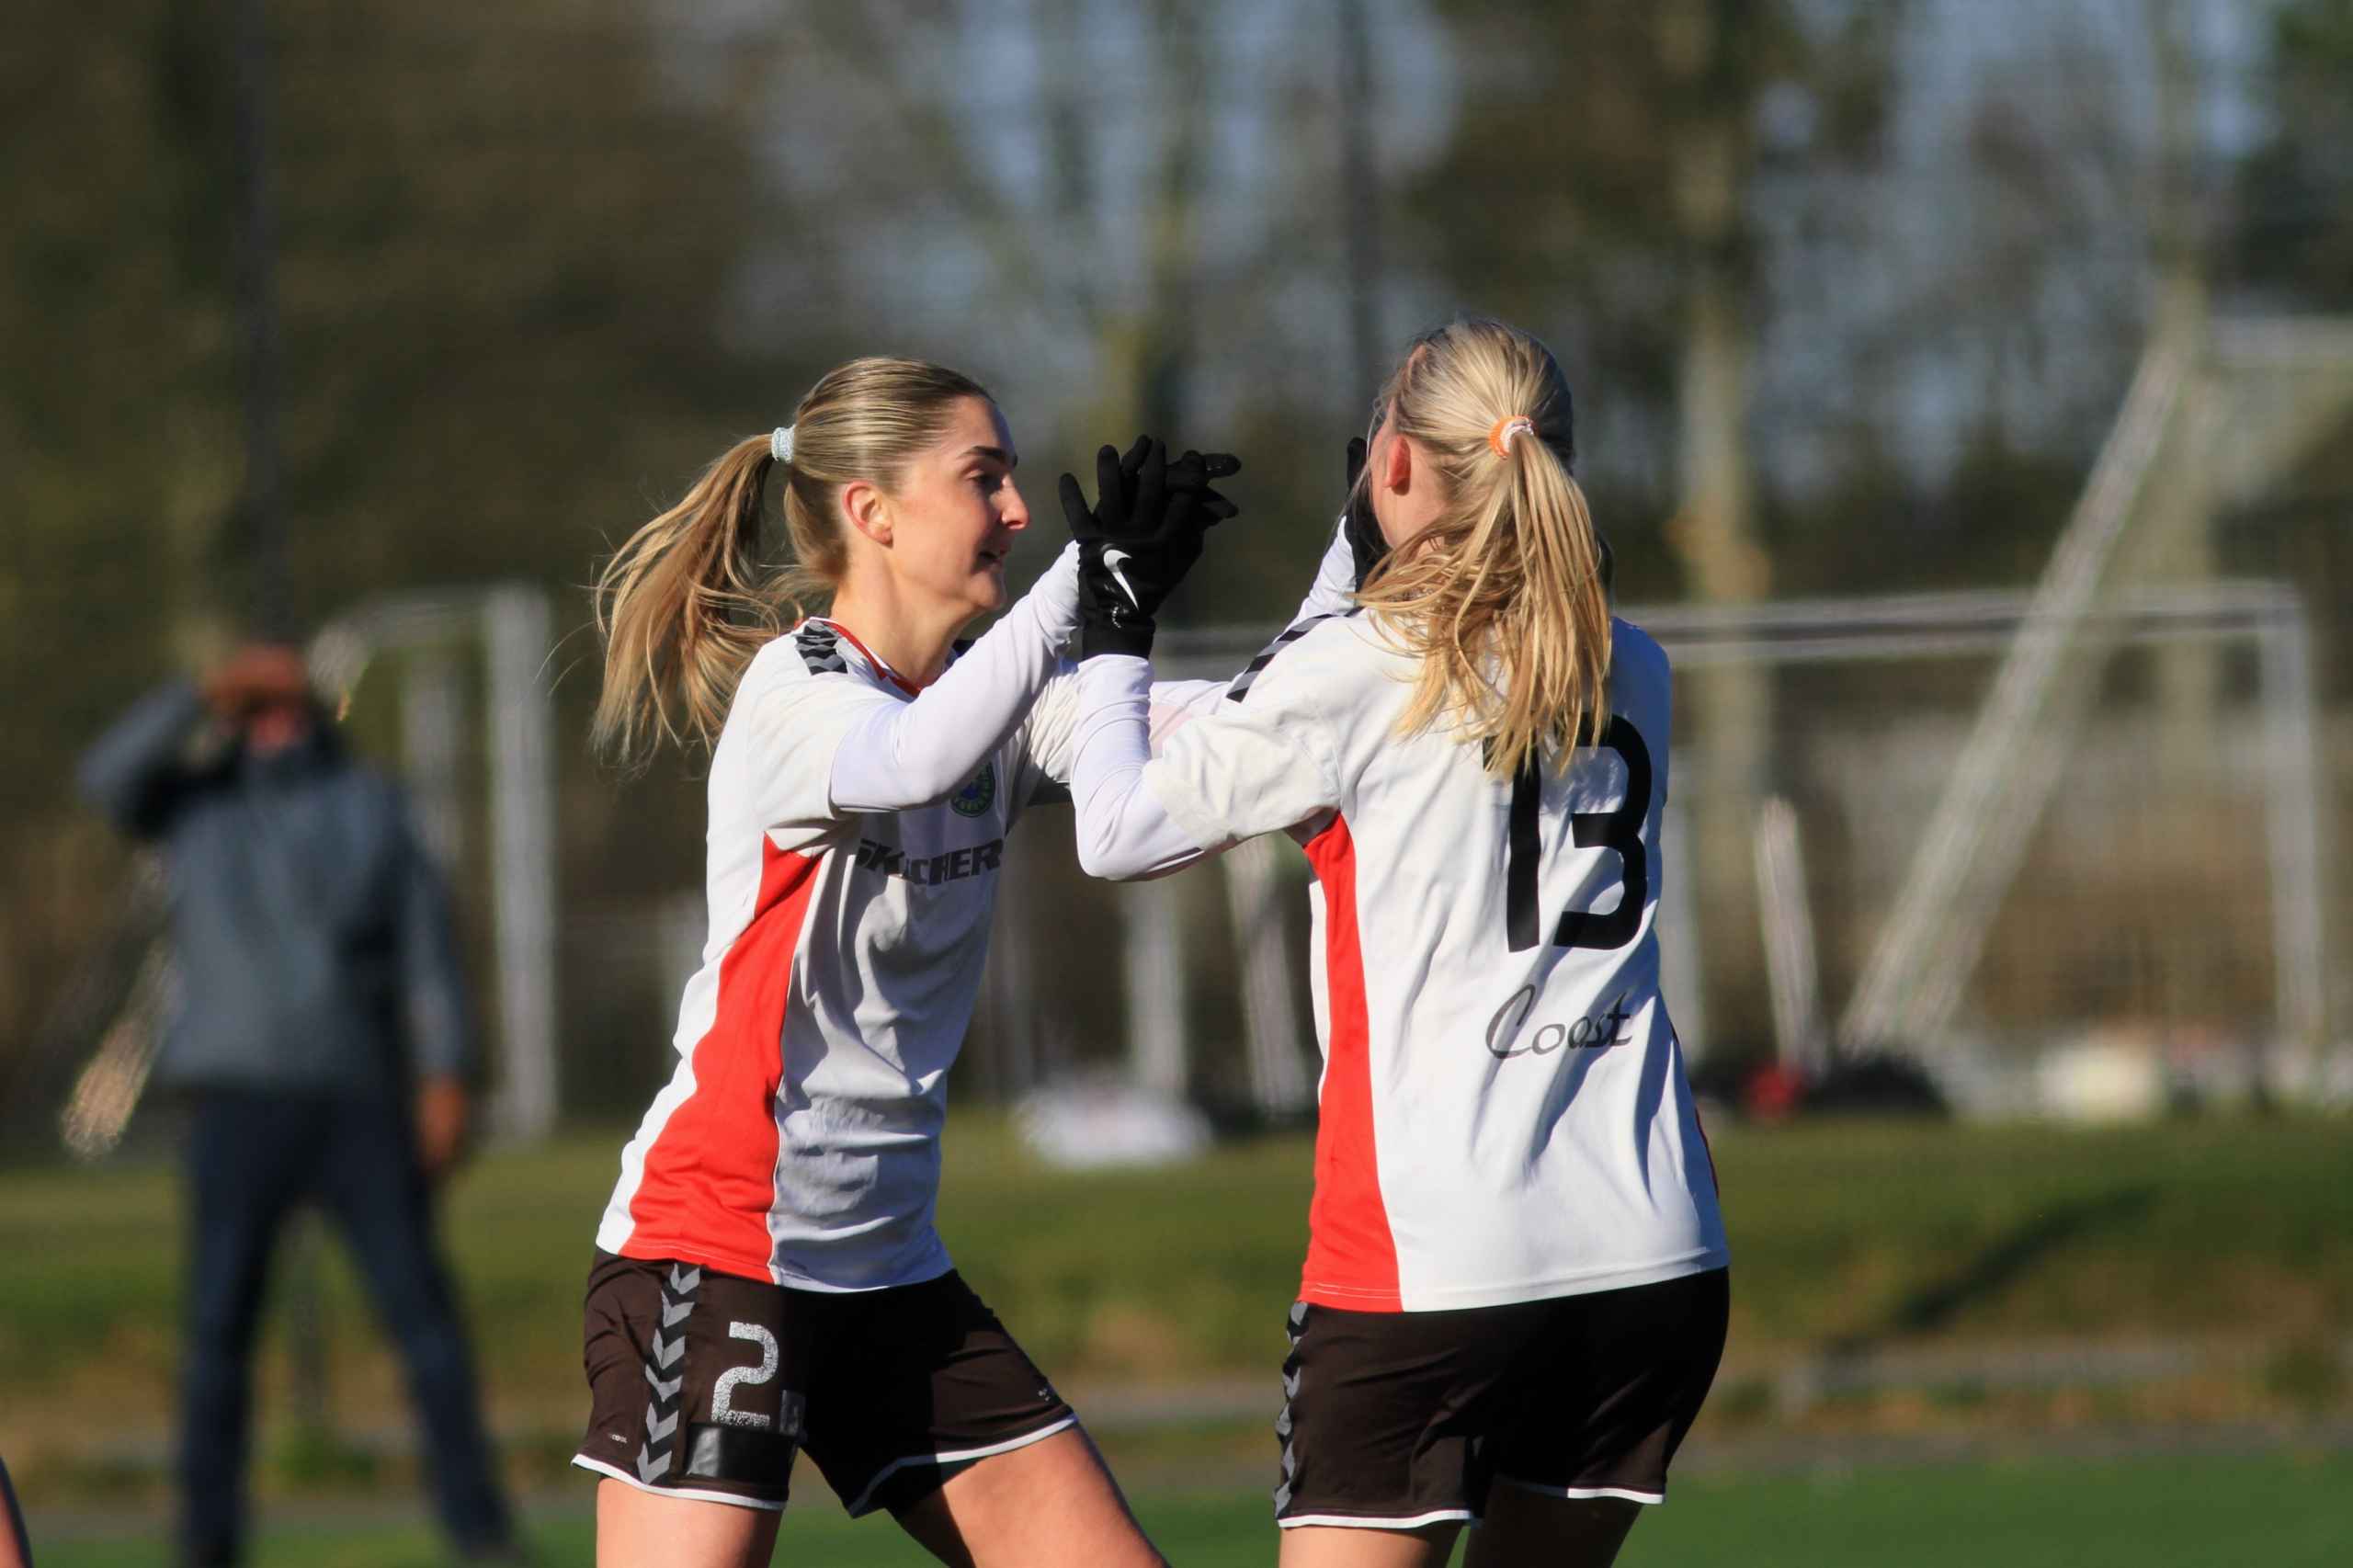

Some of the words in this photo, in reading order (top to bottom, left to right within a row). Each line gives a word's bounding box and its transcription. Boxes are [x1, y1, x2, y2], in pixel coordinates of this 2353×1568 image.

[856, 837, 1003, 885] SKCHER
[1482, 711, 1652, 953] 13
[1485, 983, 1632, 1060] Coast
[711, 1321, 779, 1426] 2
